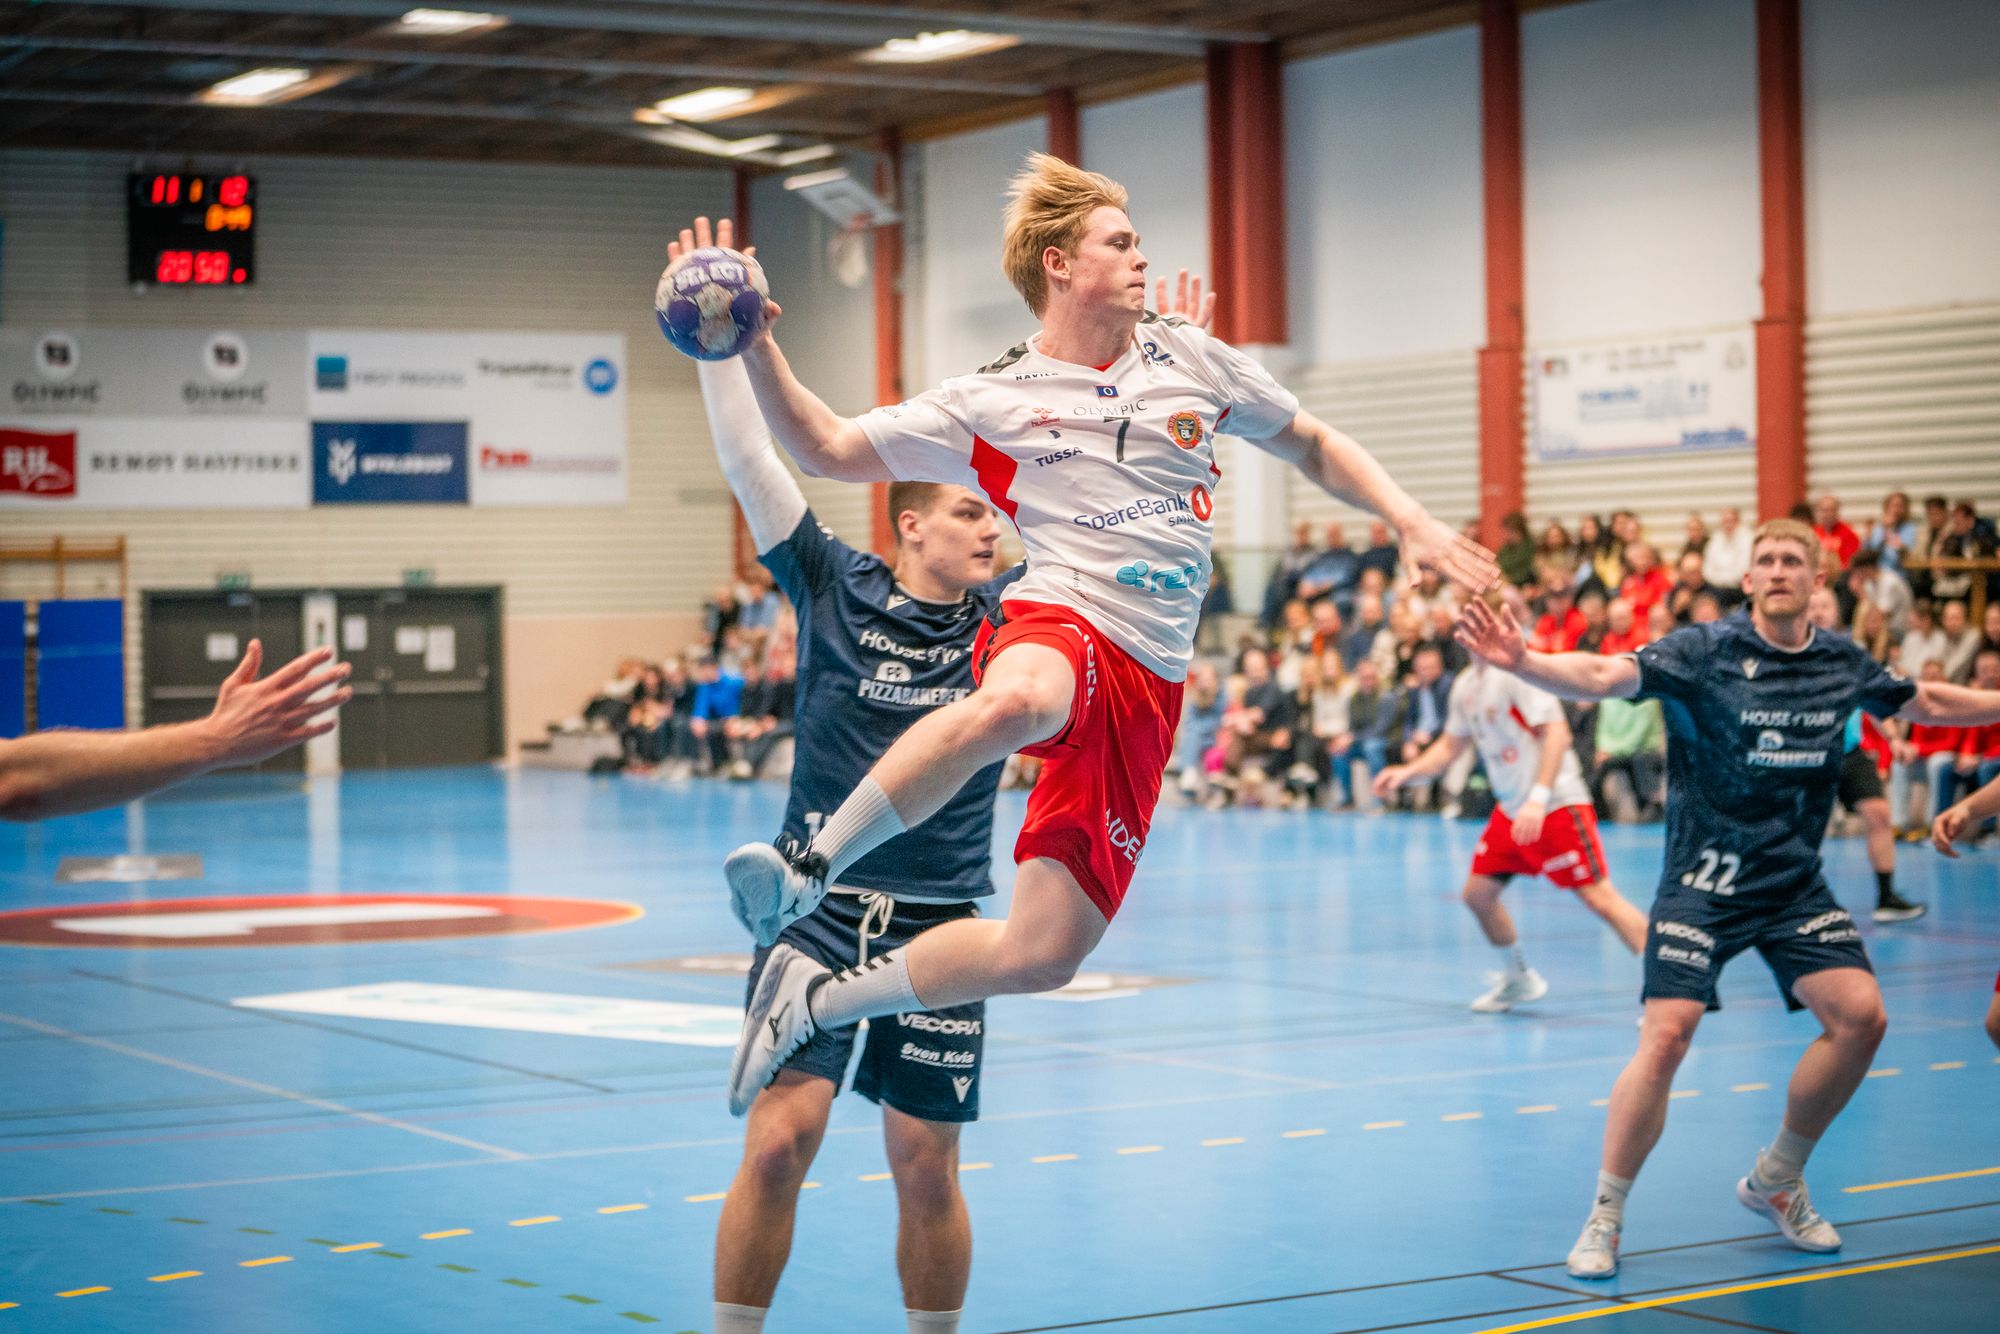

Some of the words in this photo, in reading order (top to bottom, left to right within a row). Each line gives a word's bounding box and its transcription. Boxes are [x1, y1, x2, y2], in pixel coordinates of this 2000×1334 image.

[151, 175, 180, 205] 11
[1073, 399, 1148, 418] OLYMPIC
[1035, 446, 1084, 467] TUSSA
[858, 629, 927, 662] HOUSE
[1740, 710, 1791, 726] HOUSE
[1693, 848, 1741, 896] 22
[897, 1011, 982, 1036] VECORA
[901, 1042, 941, 1062] Sven
